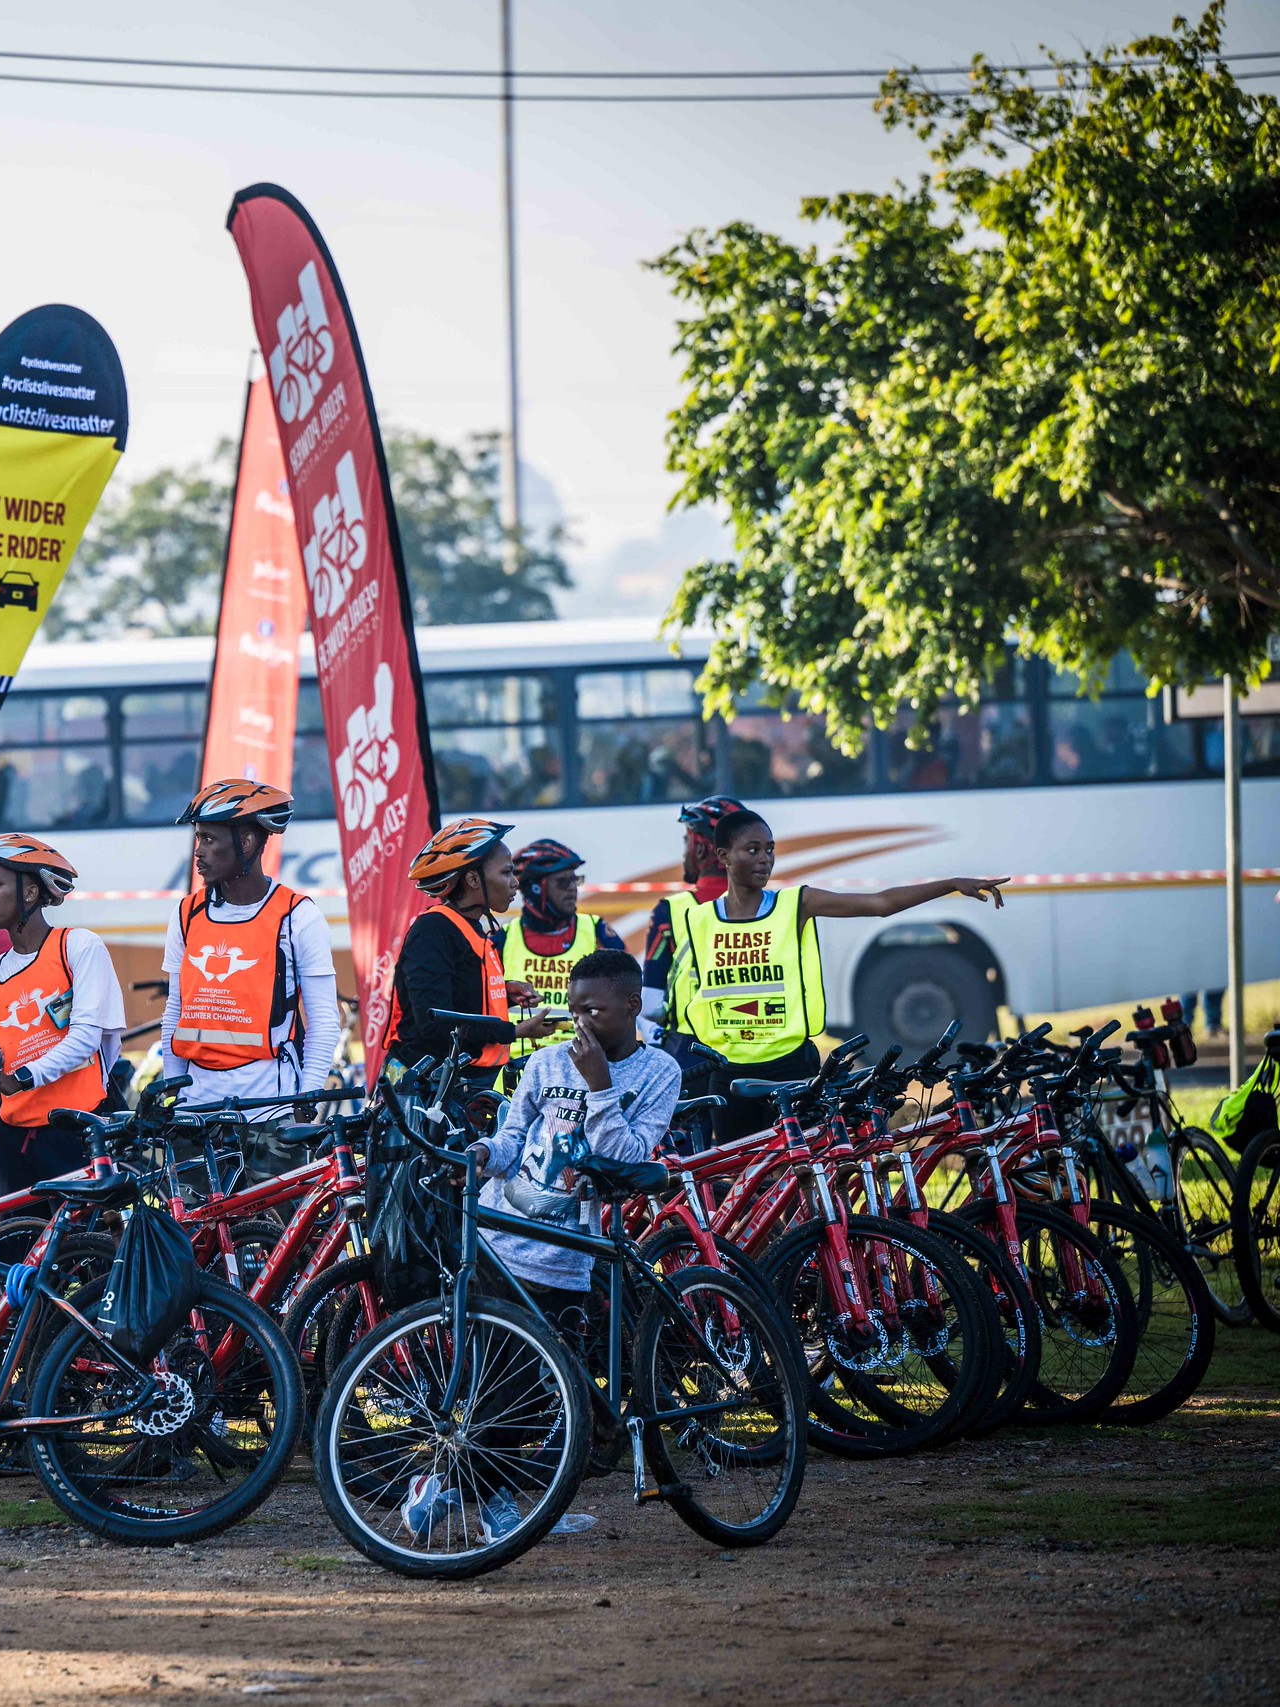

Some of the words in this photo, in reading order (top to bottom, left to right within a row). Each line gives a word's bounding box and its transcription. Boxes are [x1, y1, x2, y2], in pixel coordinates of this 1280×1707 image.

[20, 356, 83, 374] #cyclistslivesmatter
[1, 375, 97, 401] #cyclistslivesmatter
[4, 497, 66, 526] WIDER
[7, 534, 62, 563] RIDER
[714, 931, 771, 949] PLEASE
[524, 959, 573, 974] PLEASE
[715, 948, 770, 967] SHARE
[707, 966, 735, 986] THE
[740, 965, 784, 983] ROAD
[193, 998, 237, 1006] JOHANNESBURG
[544, 991, 569, 1005] ROA
[211, 1006, 246, 1015] ENGAGEMENT
[212, 1013, 252, 1024] CHAMPIONS
[16, 1036, 61, 1057] JOHANNESBURG
[205, 1252, 222, 1273] CUB
[890, 1238, 937, 1271] CUBIXX
[1093, 1259, 1119, 1305] CUBIXX
[305, 1287, 336, 1329] CUBIXX
[1016, 1308, 1026, 1357] CUBIXX
[1186, 1313, 1198, 1360] CUBIXX
[37, 1444, 81, 1502] MAXXIS
[122, 1498, 179, 1515] CUBIXX
